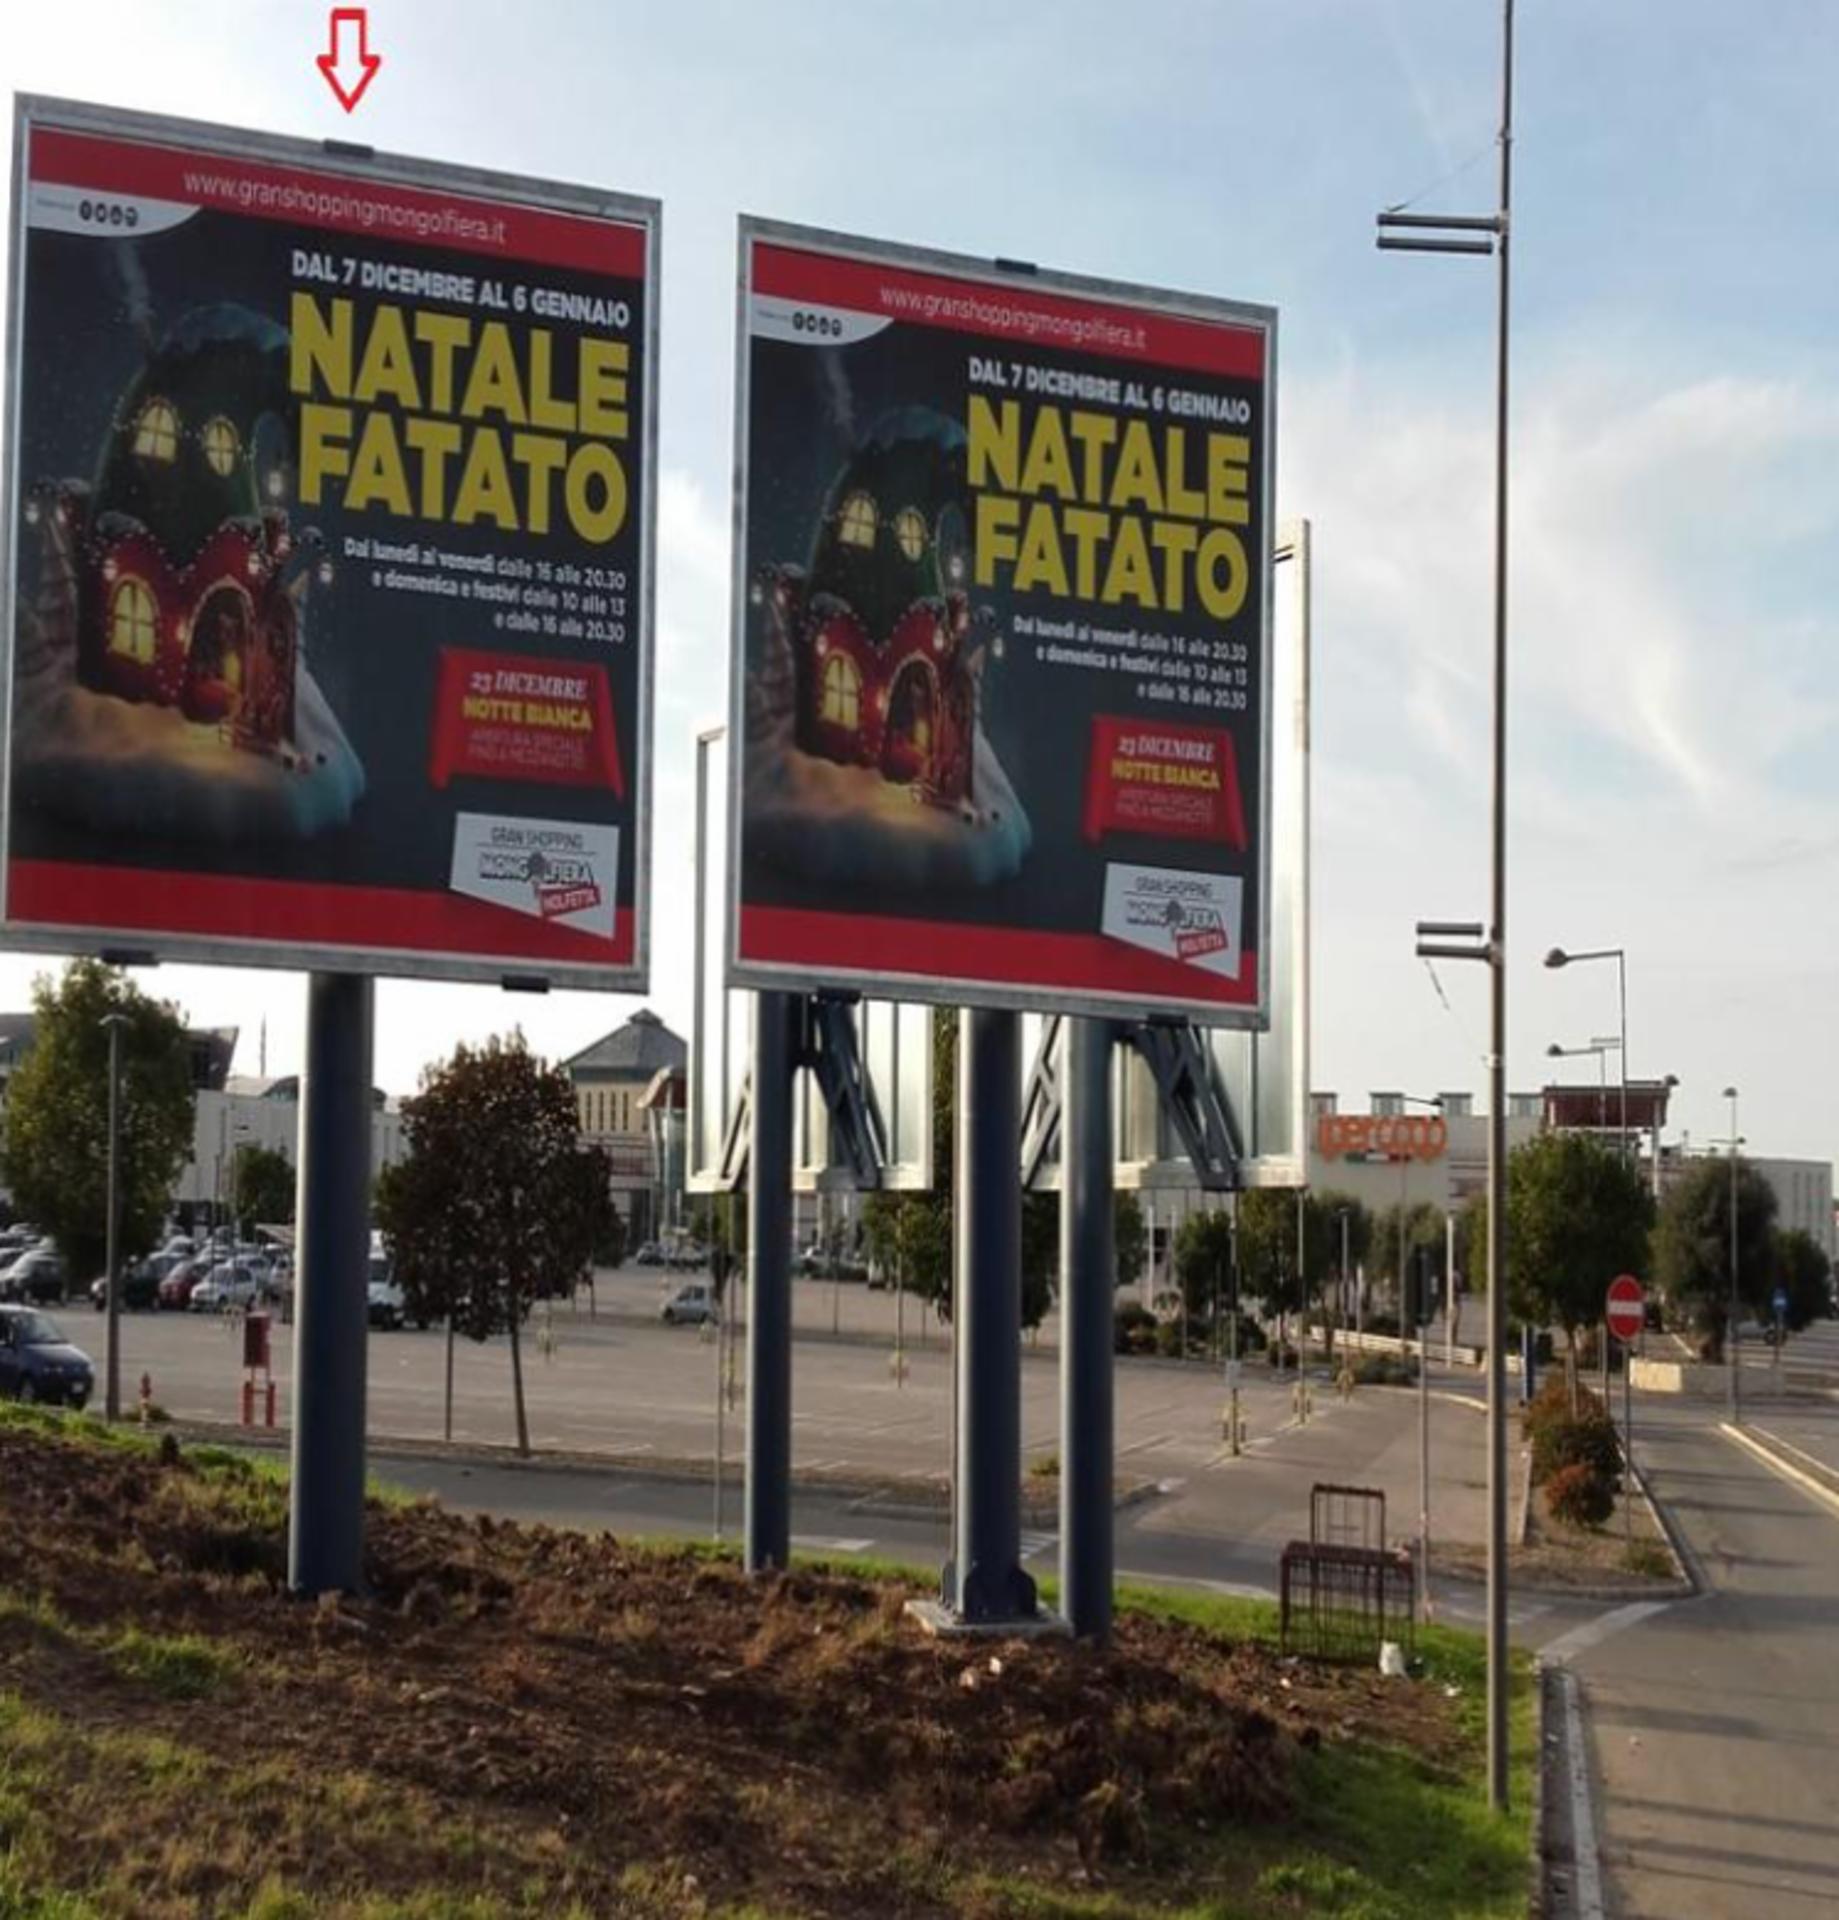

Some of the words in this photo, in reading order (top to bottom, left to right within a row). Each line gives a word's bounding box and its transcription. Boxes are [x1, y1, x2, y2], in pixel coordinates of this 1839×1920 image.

[183, 171, 506, 243] www.granshoppingmongolfiera.it
[292, 250, 338, 283] DAL
[341, 259, 357, 284] 7
[361, 261, 475, 303] DICEMBRE
[478, 279, 509, 308] AL
[513, 285, 527, 312] 6
[531, 288, 630, 328] GENNAIO
[290, 291, 630, 440] NATALE
[969, 356, 1007, 386] DAL
[1011, 365, 1022, 388] 7
[1026, 365, 1120, 404] DICEMBRE
[1122, 383, 1149, 408] AL
[1152, 386, 1164, 411] 6
[1167, 389, 1250, 425] GENNAIO
[299, 402, 629, 544] FATATO
[966, 393, 1251, 525] NATALE
[372, 570, 381, 587] e
[385, 569, 458, 596] domenica
[461, 581, 470, 597] e
[555, 565, 581, 584] alle
[975, 493, 1249, 619] FATATO
[494, 612, 504, 628] e
[462, 696, 523, 723] NOTTE
[526, 702, 593, 731] BIANCA
[495, 670, 588, 700] DICEMBRE
[1111, 758, 1160, 783] NOTTE
